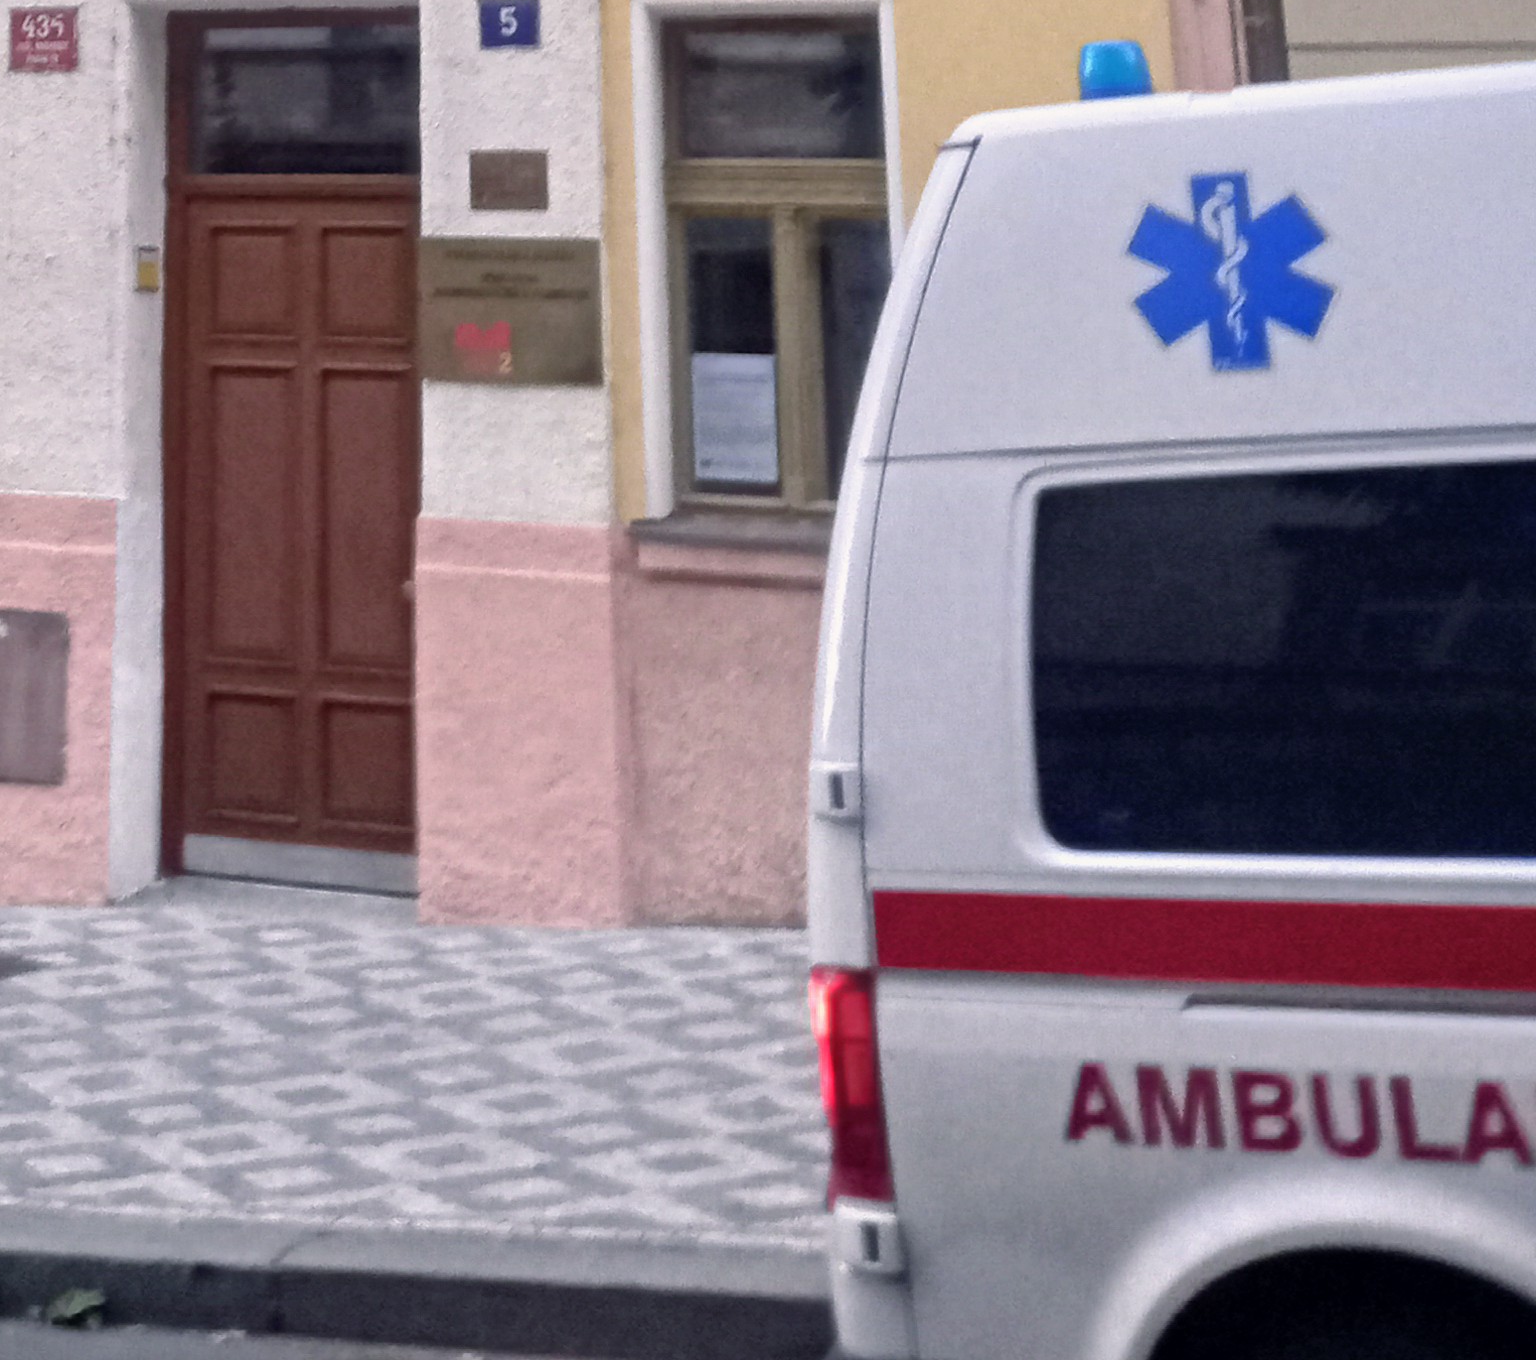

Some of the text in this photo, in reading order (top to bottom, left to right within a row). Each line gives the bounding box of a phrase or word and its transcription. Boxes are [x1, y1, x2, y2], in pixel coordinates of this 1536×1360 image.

[499, 6, 518, 37] 5
[498, 350, 512, 375] 2
[1065, 1062, 1535, 1166] AMBULA
